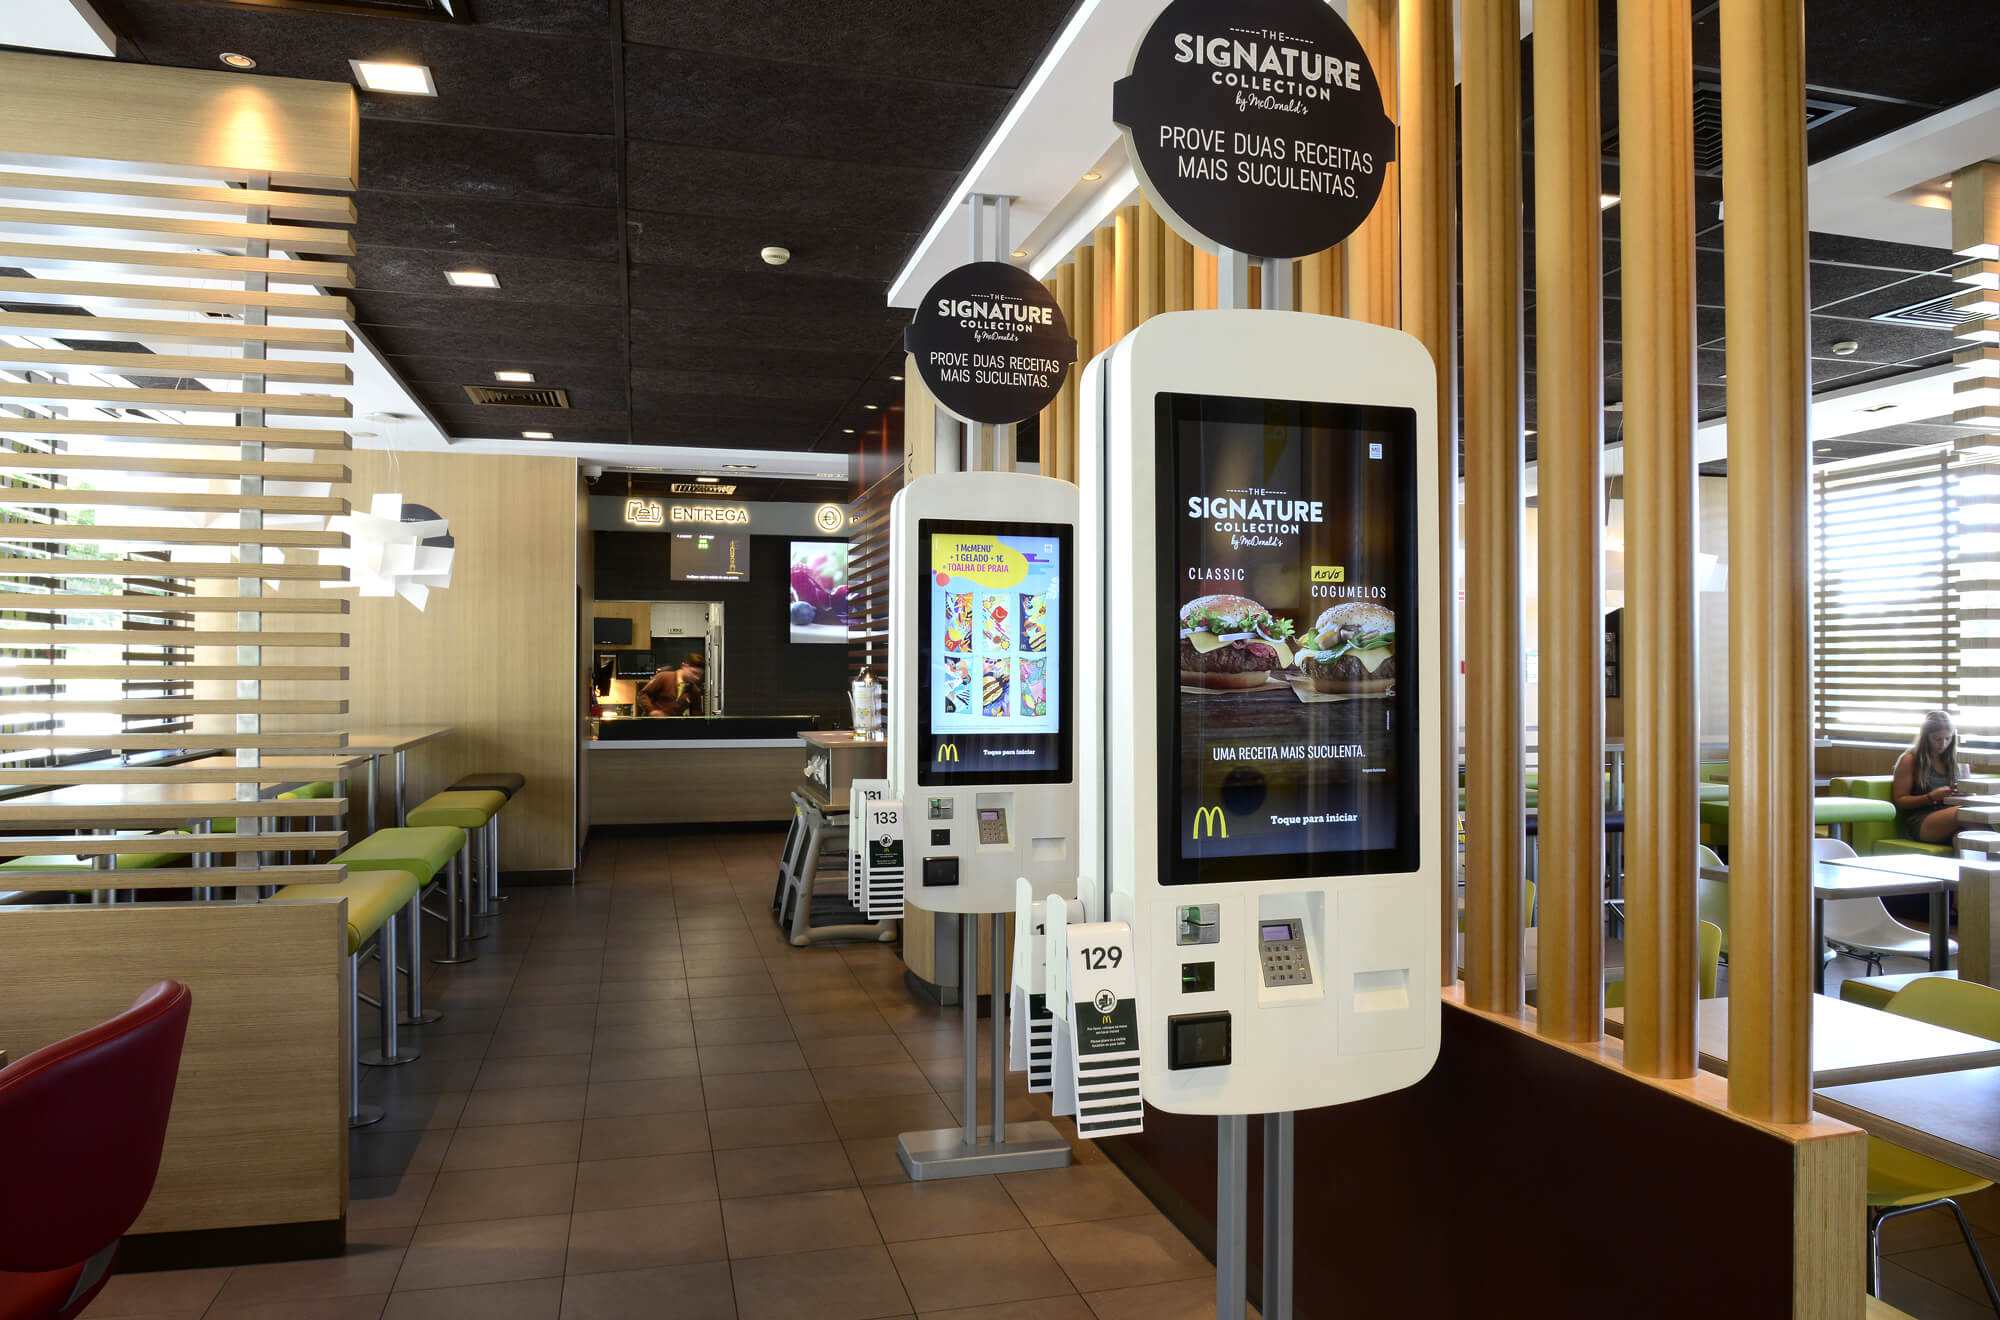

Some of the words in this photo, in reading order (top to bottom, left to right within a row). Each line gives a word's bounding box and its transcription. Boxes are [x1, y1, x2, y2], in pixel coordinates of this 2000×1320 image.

[1261, 29, 1285, 42] THE
[1174, 33, 1361, 91] SIGNATURE
[1211, 71, 1331, 101] COLLECTION
[1235, 90, 1248, 112] by
[1248, 93, 1309, 115] McDonald's
[1159, 125, 1225, 153] PROVE
[1234, 132, 1286, 160] DUAS
[1294, 140, 1374, 175] RECEITAS
[1178, 155, 1228, 181] MAIS
[1237, 160, 1359, 199] SUCULENTAS.
[990, 293, 1005, 301] THE
[937, 299, 1053, 325] SIGNATURE
[960, 319, 1033, 333] COLLECTION
[974, 330, 982, 343] by
[930, 351, 968, 367] PROVE
[973, 354, 1005, 369] DUAS
[1009, 356, 1060, 373] RECEITAS
[940, 368, 970, 383] MAIS
[975, 370, 1050, 388] SUCULENTAS.
[1248, 488, 1266, 496] THE
[672, 507, 748, 523] ENTREGA
[1188, 496, 1323, 522] SIGNATURE
[1214, 522, 1300, 534] COLLECTION
[1231, 535, 1240, 550] by
[1240, 536, 1283, 547] McDonald's
[961, 554, 988, 562] GELADO
[948, 563, 975, 572] TOALHA
[977, 564, 985, 572] DE
[988, 564, 1008, 573] PRAIA
[1188, 567, 1245, 581] CLASSIC
[1311, 585, 1387, 599] COGUMELOS
[1213, 747, 1236, 761] UMA
[1238, 746, 1278, 760] RECEITA
[1280, 746, 1304, 759] MAIS
[1307, 745, 1366, 759] SUCULENTA.
[873, 811, 898, 824] 133
[1271, 815, 1301, 826] Toque
[1302, 815, 1324, 825] para
[1326, 813, 1357, 823] iniciar
[1080, 946, 1123, 970] 129
